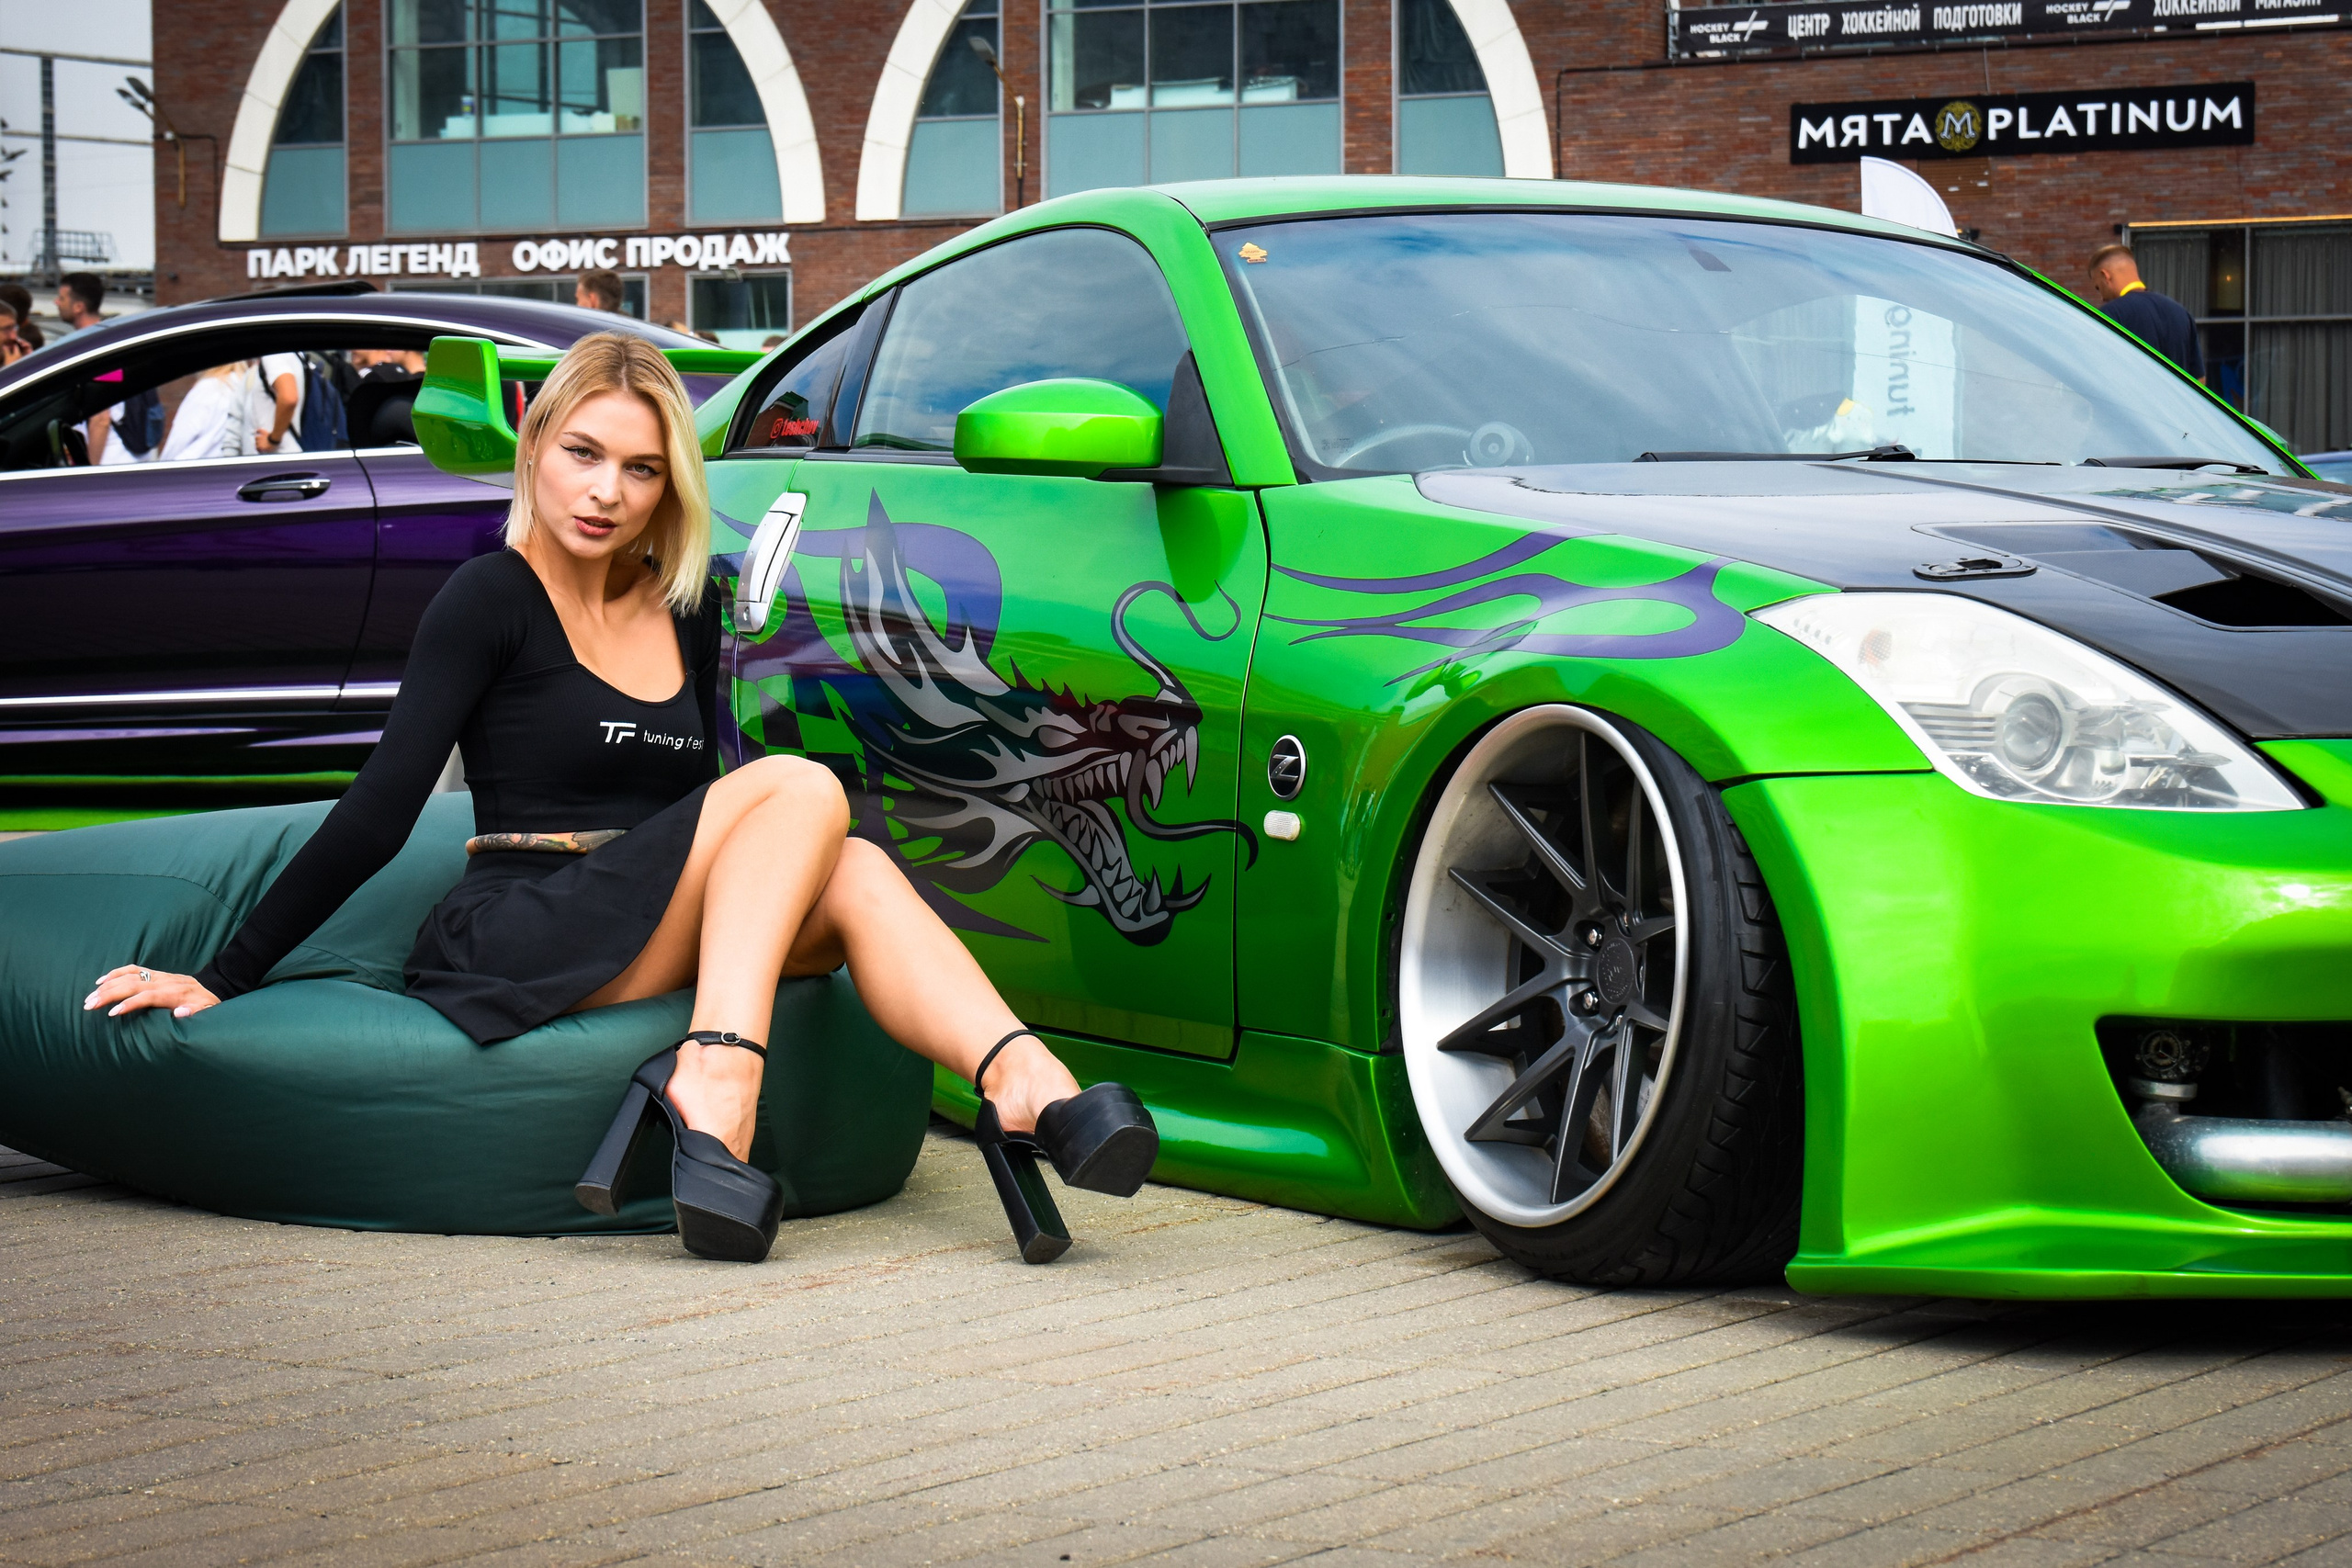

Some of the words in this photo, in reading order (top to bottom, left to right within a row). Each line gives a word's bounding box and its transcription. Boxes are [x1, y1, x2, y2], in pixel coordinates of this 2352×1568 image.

[1788, 13, 1831, 40] ЦЕНТР
[1841, 3, 1921, 35] ХОККЕЙНОЙ
[1933, 2, 2022, 31] ПОДГОТОВКИ
[2046, 2, 2089, 15] HOCKEY
[2067, 14, 2101, 25] BLACK
[1690, 22, 1731, 34] HOCKEY
[1709, 33, 1741, 44] BLACK
[1798, 113, 1933, 150] МЯТА
[1987, 96, 2242, 141] PLATINUM
[247, 246, 340, 278] ПАРК
[345, 243, 481, 277] ЛЕГЕНД
[512, 238, 618, 272] ОФИС
[626, 232, 793, 269] ПРОДАЖ
[599, 721, 637, 744] TF
[643, 729, 684, 750] tuning
